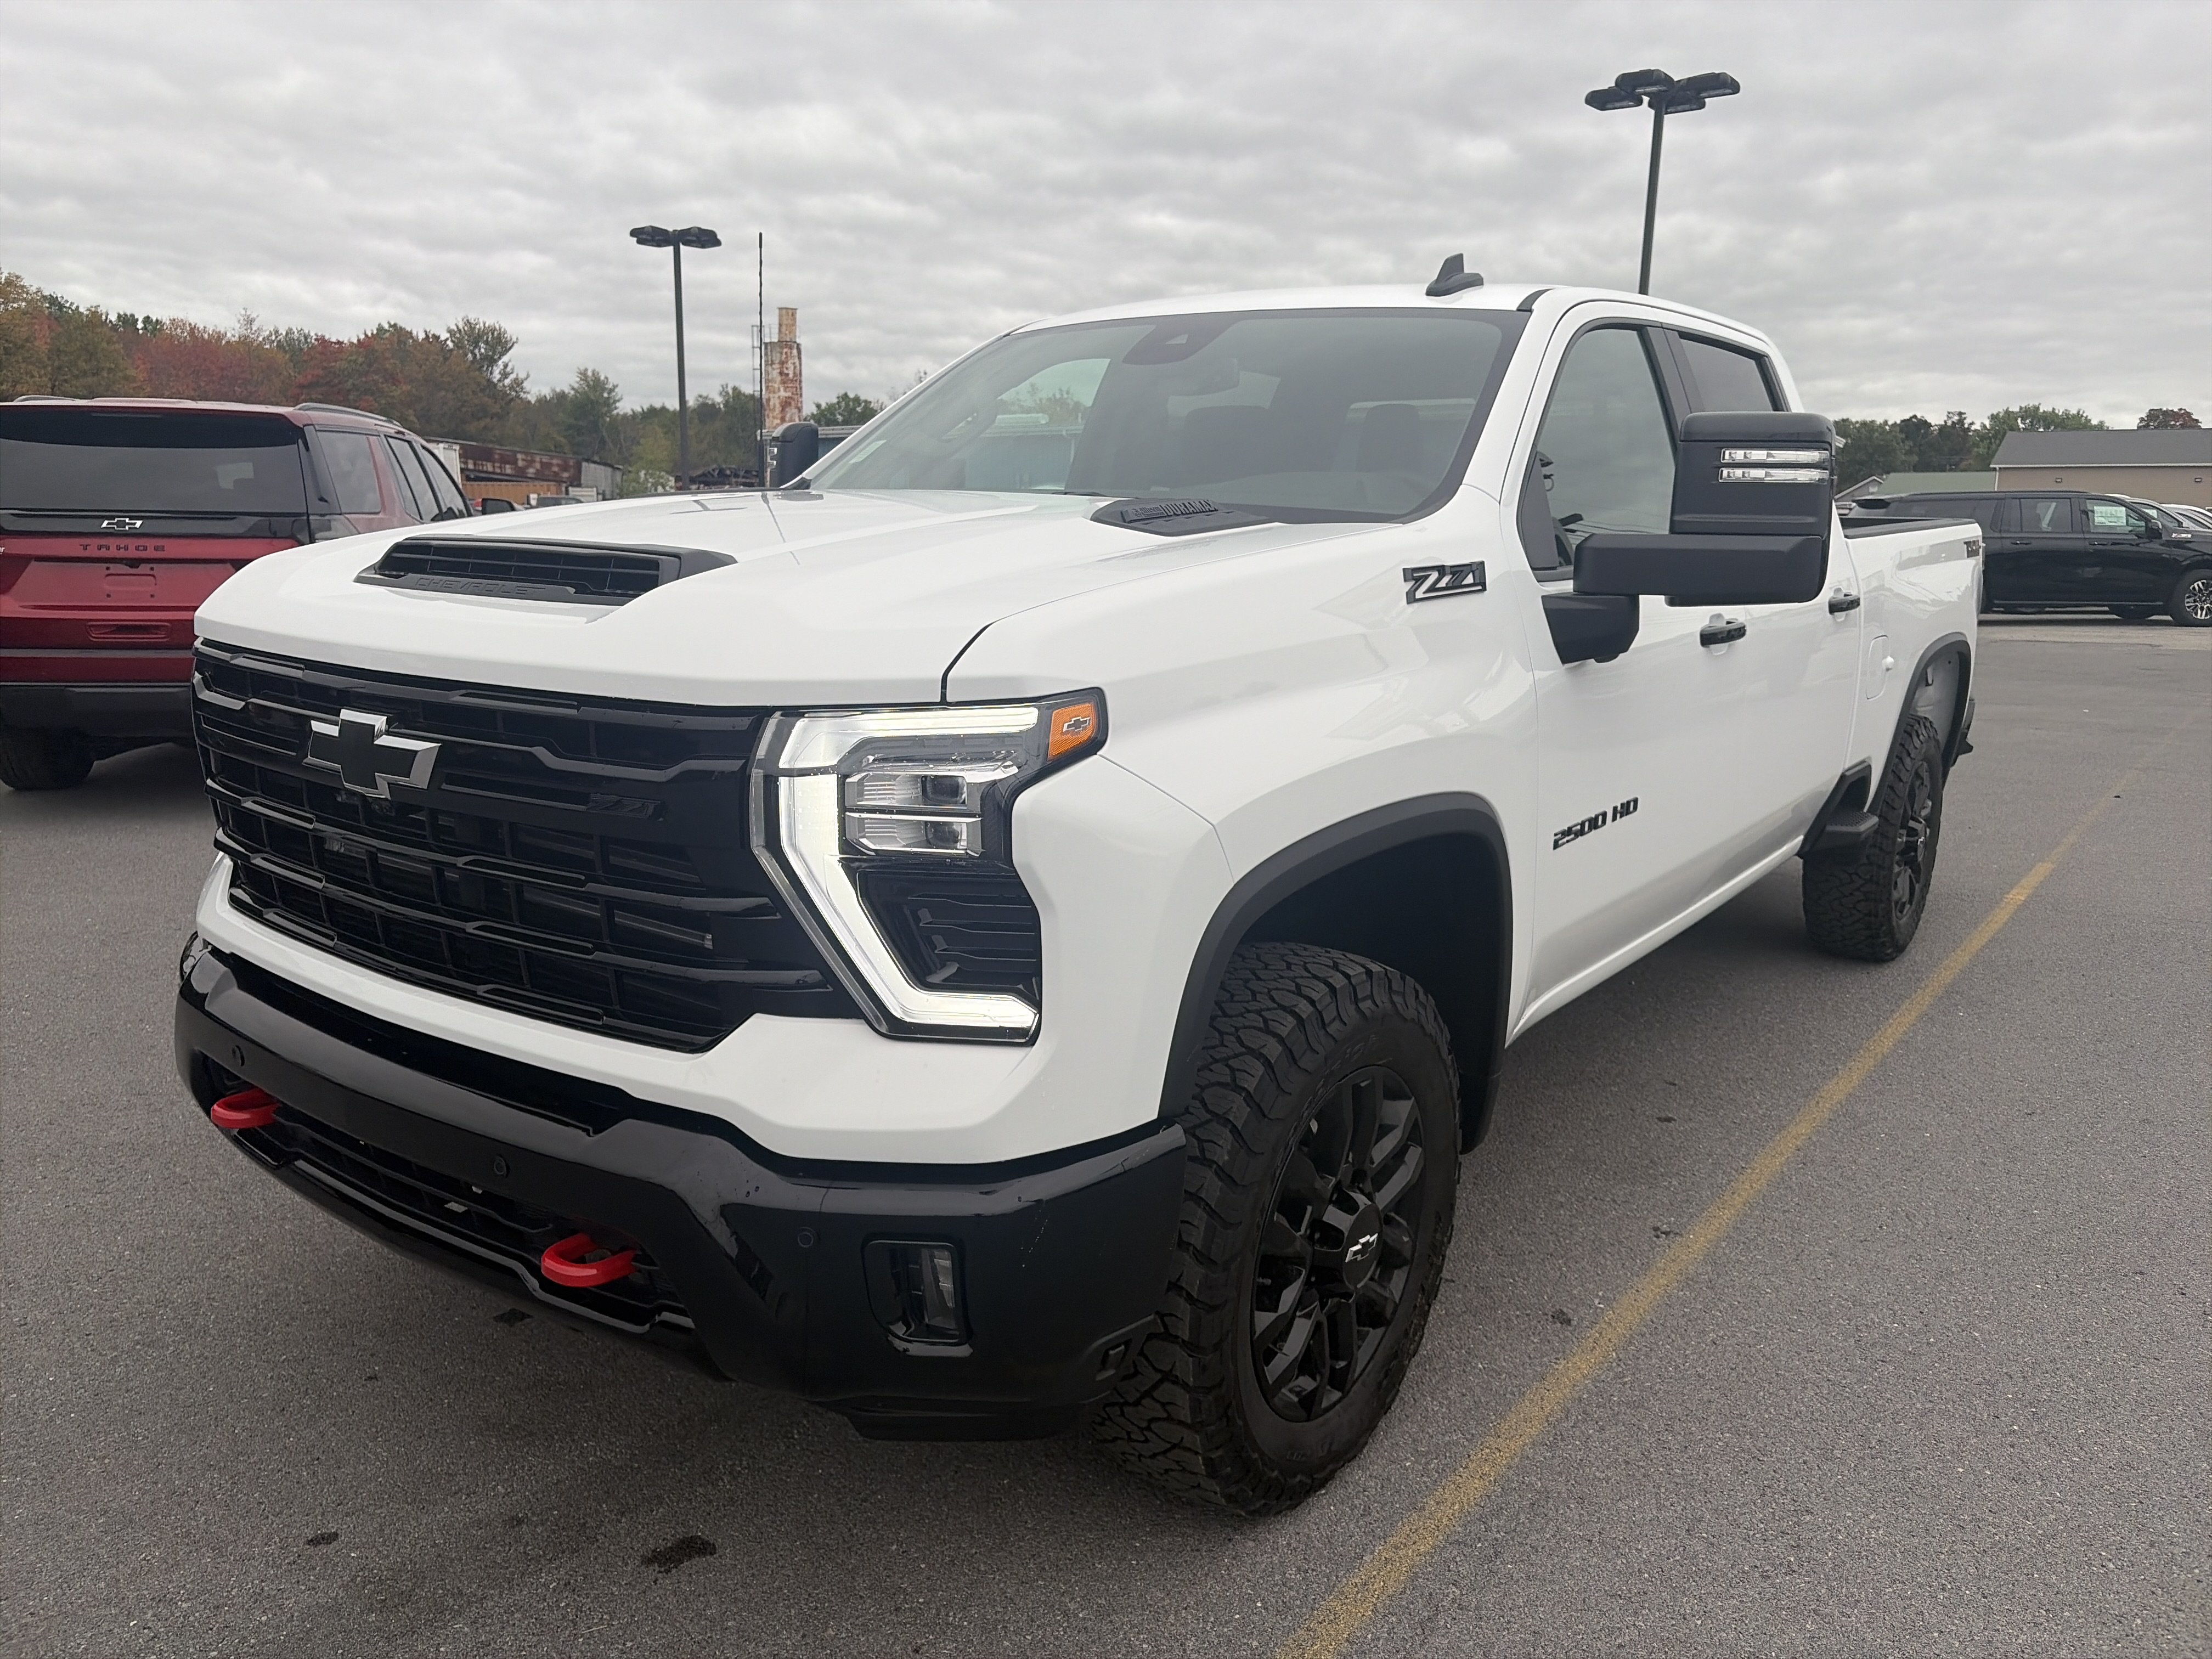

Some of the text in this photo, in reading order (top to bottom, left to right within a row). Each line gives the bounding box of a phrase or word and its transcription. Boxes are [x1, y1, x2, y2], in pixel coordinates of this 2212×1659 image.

[1164, 500, 1218, 516] DURAMAX
[1402, 560, 1487, 605] Z71
[1553, 797, 1639, 850] 2500 HD
